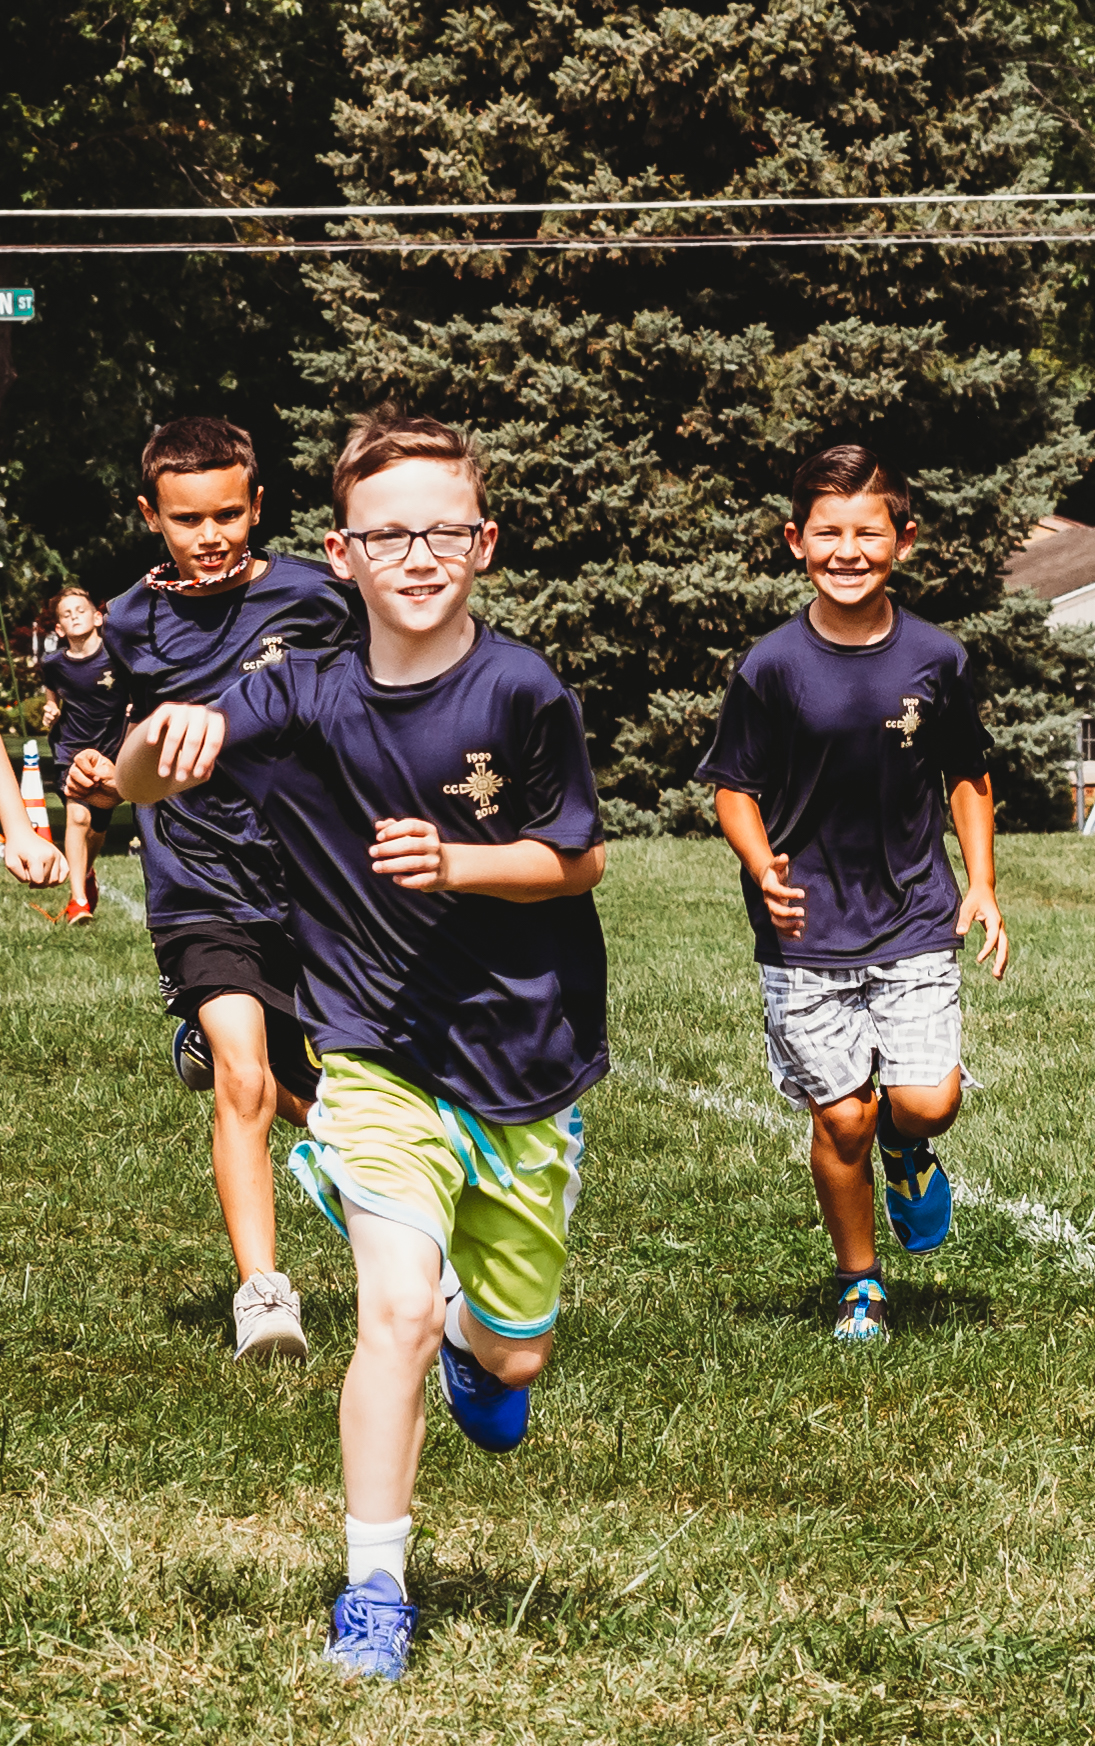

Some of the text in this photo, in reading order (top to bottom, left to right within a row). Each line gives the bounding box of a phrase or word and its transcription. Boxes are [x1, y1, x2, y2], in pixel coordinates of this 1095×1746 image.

[18, 297, 33, 309] ST
[466, 753, 492, 763] 1999
[443, 785, 459, 794] CC
[475, 805, 499, 820] 2019
